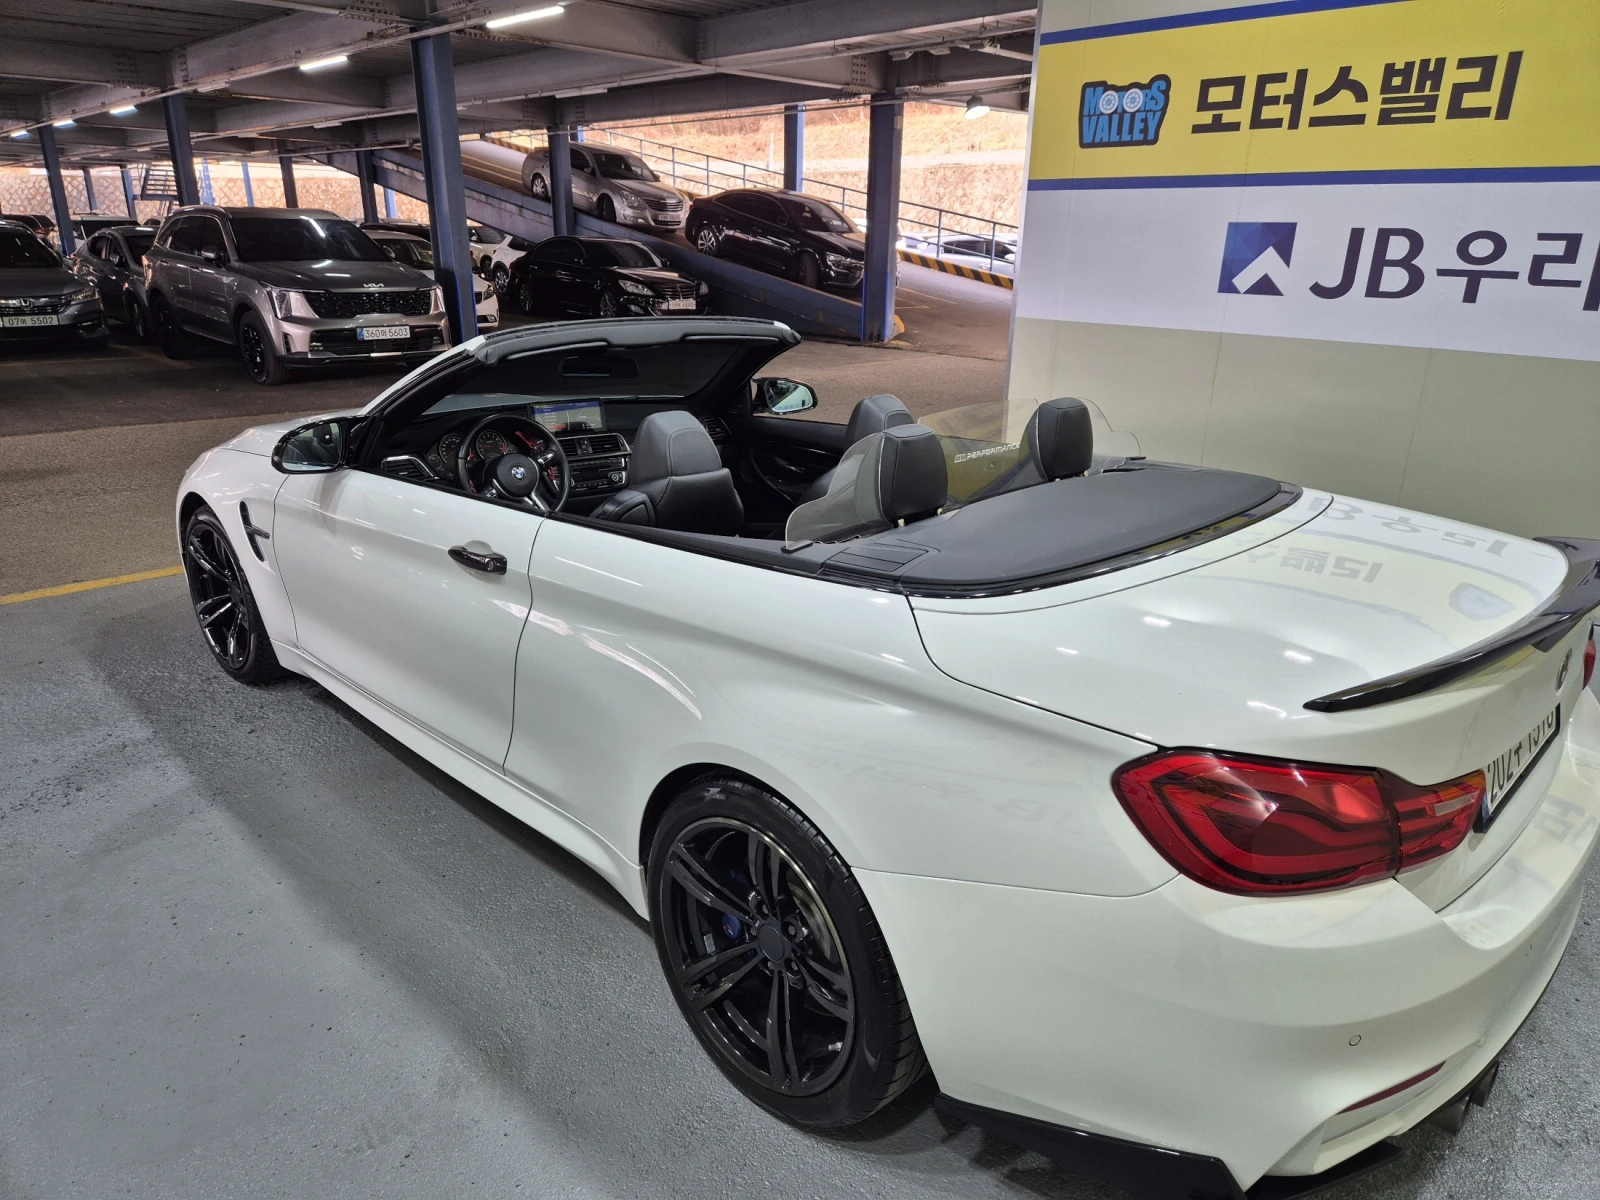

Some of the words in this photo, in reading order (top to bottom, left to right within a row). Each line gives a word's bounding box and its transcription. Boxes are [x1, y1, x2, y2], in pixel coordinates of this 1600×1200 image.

[1190, 50, 1524, 134] 모터스밸리
[1082, 111, 1162, 144] VALLEY
[30, 316, 54, 325] 5502
[388, 328, 408, 337] 5603
[967, 442, 1020, 459] PERFORMANCE
